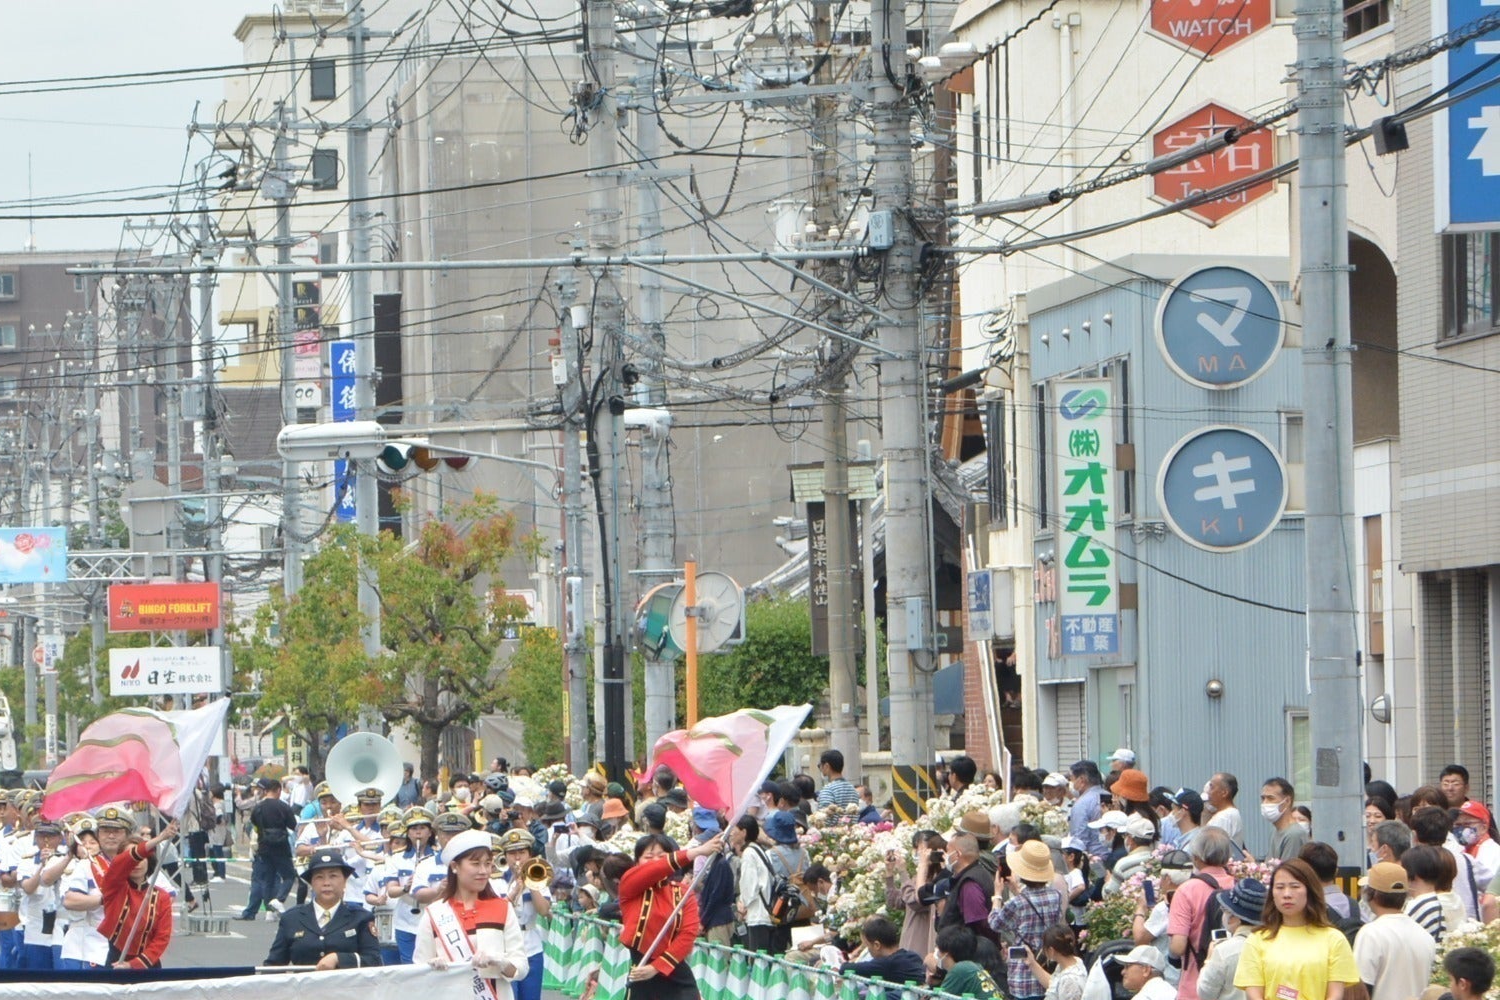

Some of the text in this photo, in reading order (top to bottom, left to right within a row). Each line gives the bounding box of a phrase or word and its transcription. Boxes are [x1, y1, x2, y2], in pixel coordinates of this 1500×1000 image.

[1169, 18, 1252, 37] WATCH
[1190, 287, 1252, 347] マ
[1193, 451, 1256, 509] キ
[138, 602, 212, 615] BINGO FORKLIFT
[1065, 618, 1115, 633] 不動産
[1070, 635, 1110, 652] 建築
